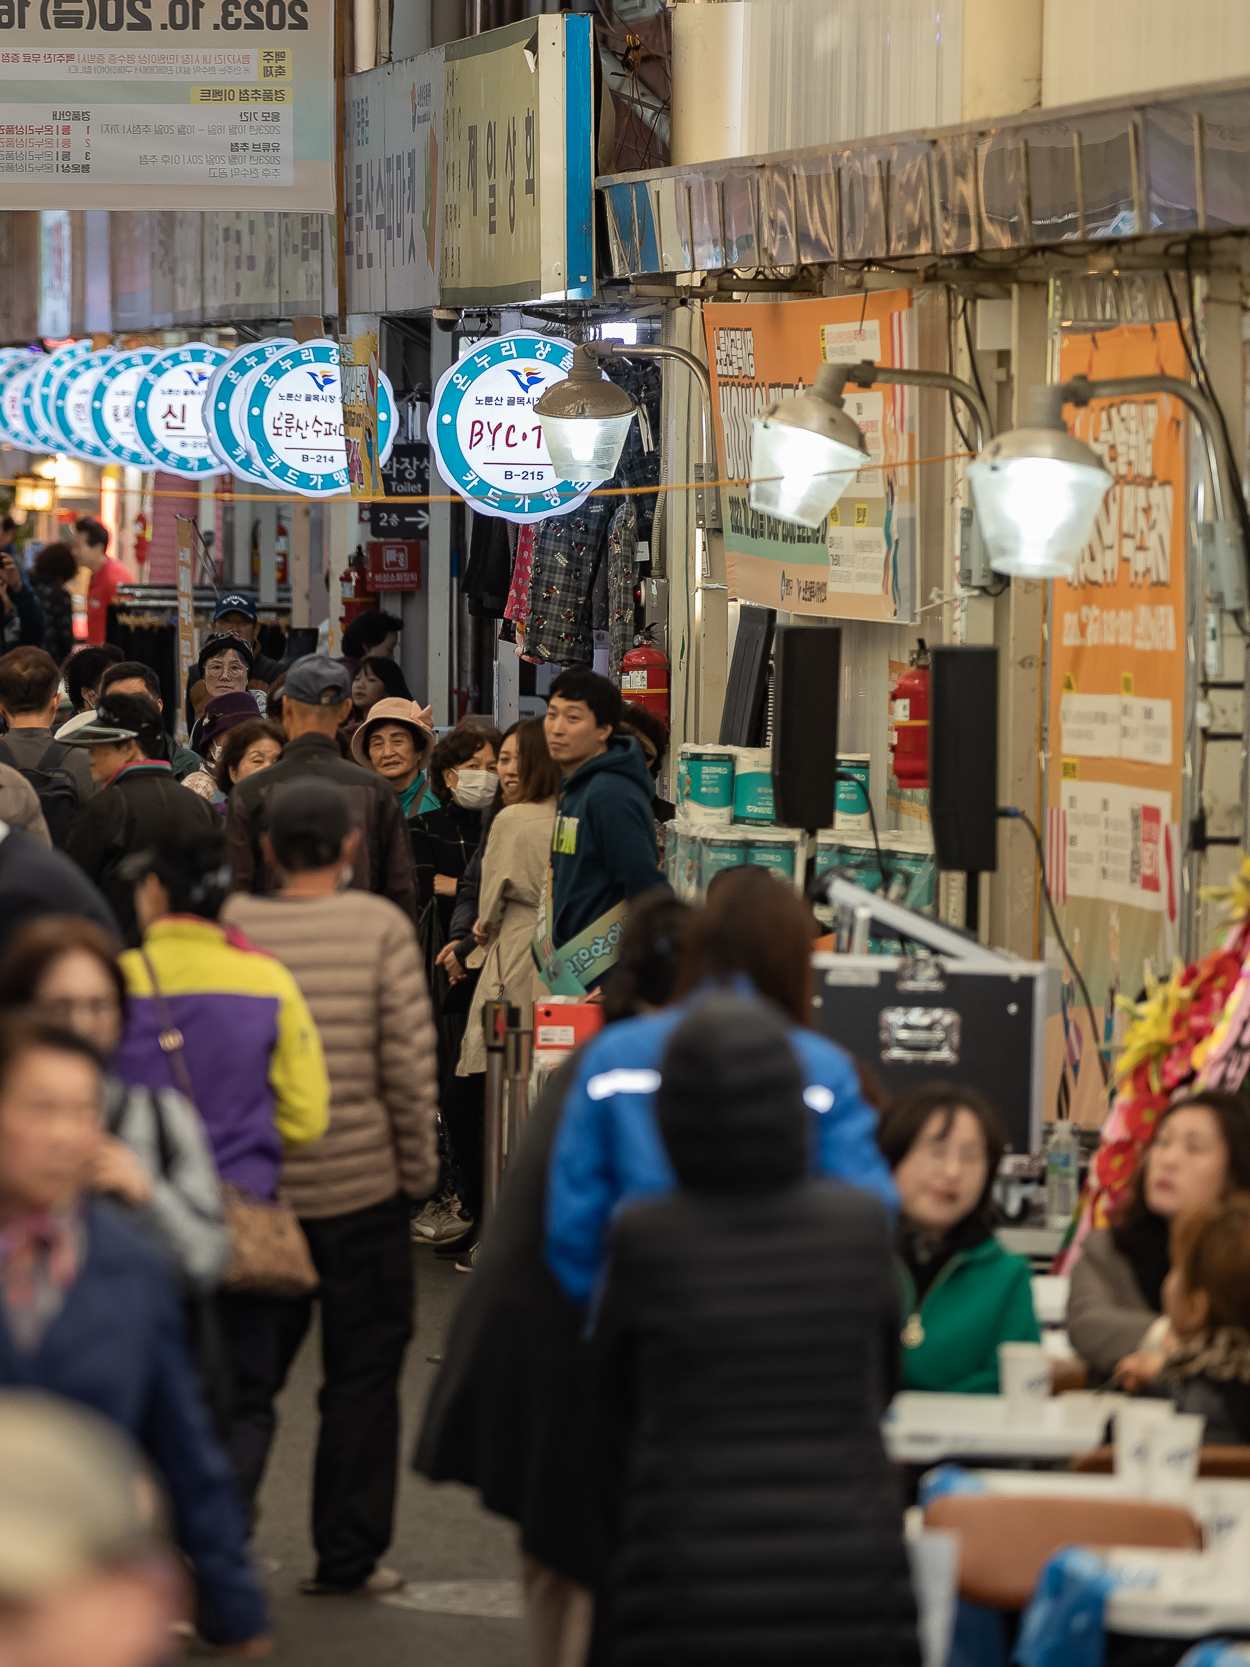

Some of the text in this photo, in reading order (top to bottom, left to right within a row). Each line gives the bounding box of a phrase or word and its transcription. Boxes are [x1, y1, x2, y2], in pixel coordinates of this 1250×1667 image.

[467, 107, 536, 237] 제일상회
[475, 396, 504, 406] 노룬산
[162, 404, 186, 430] 신
[302, 453, 335, 464] B-214
[504, 471, 544, 482] B-215
[389, 481, 423, 494] Toilet
[379, 512, 401, 528] 2층
